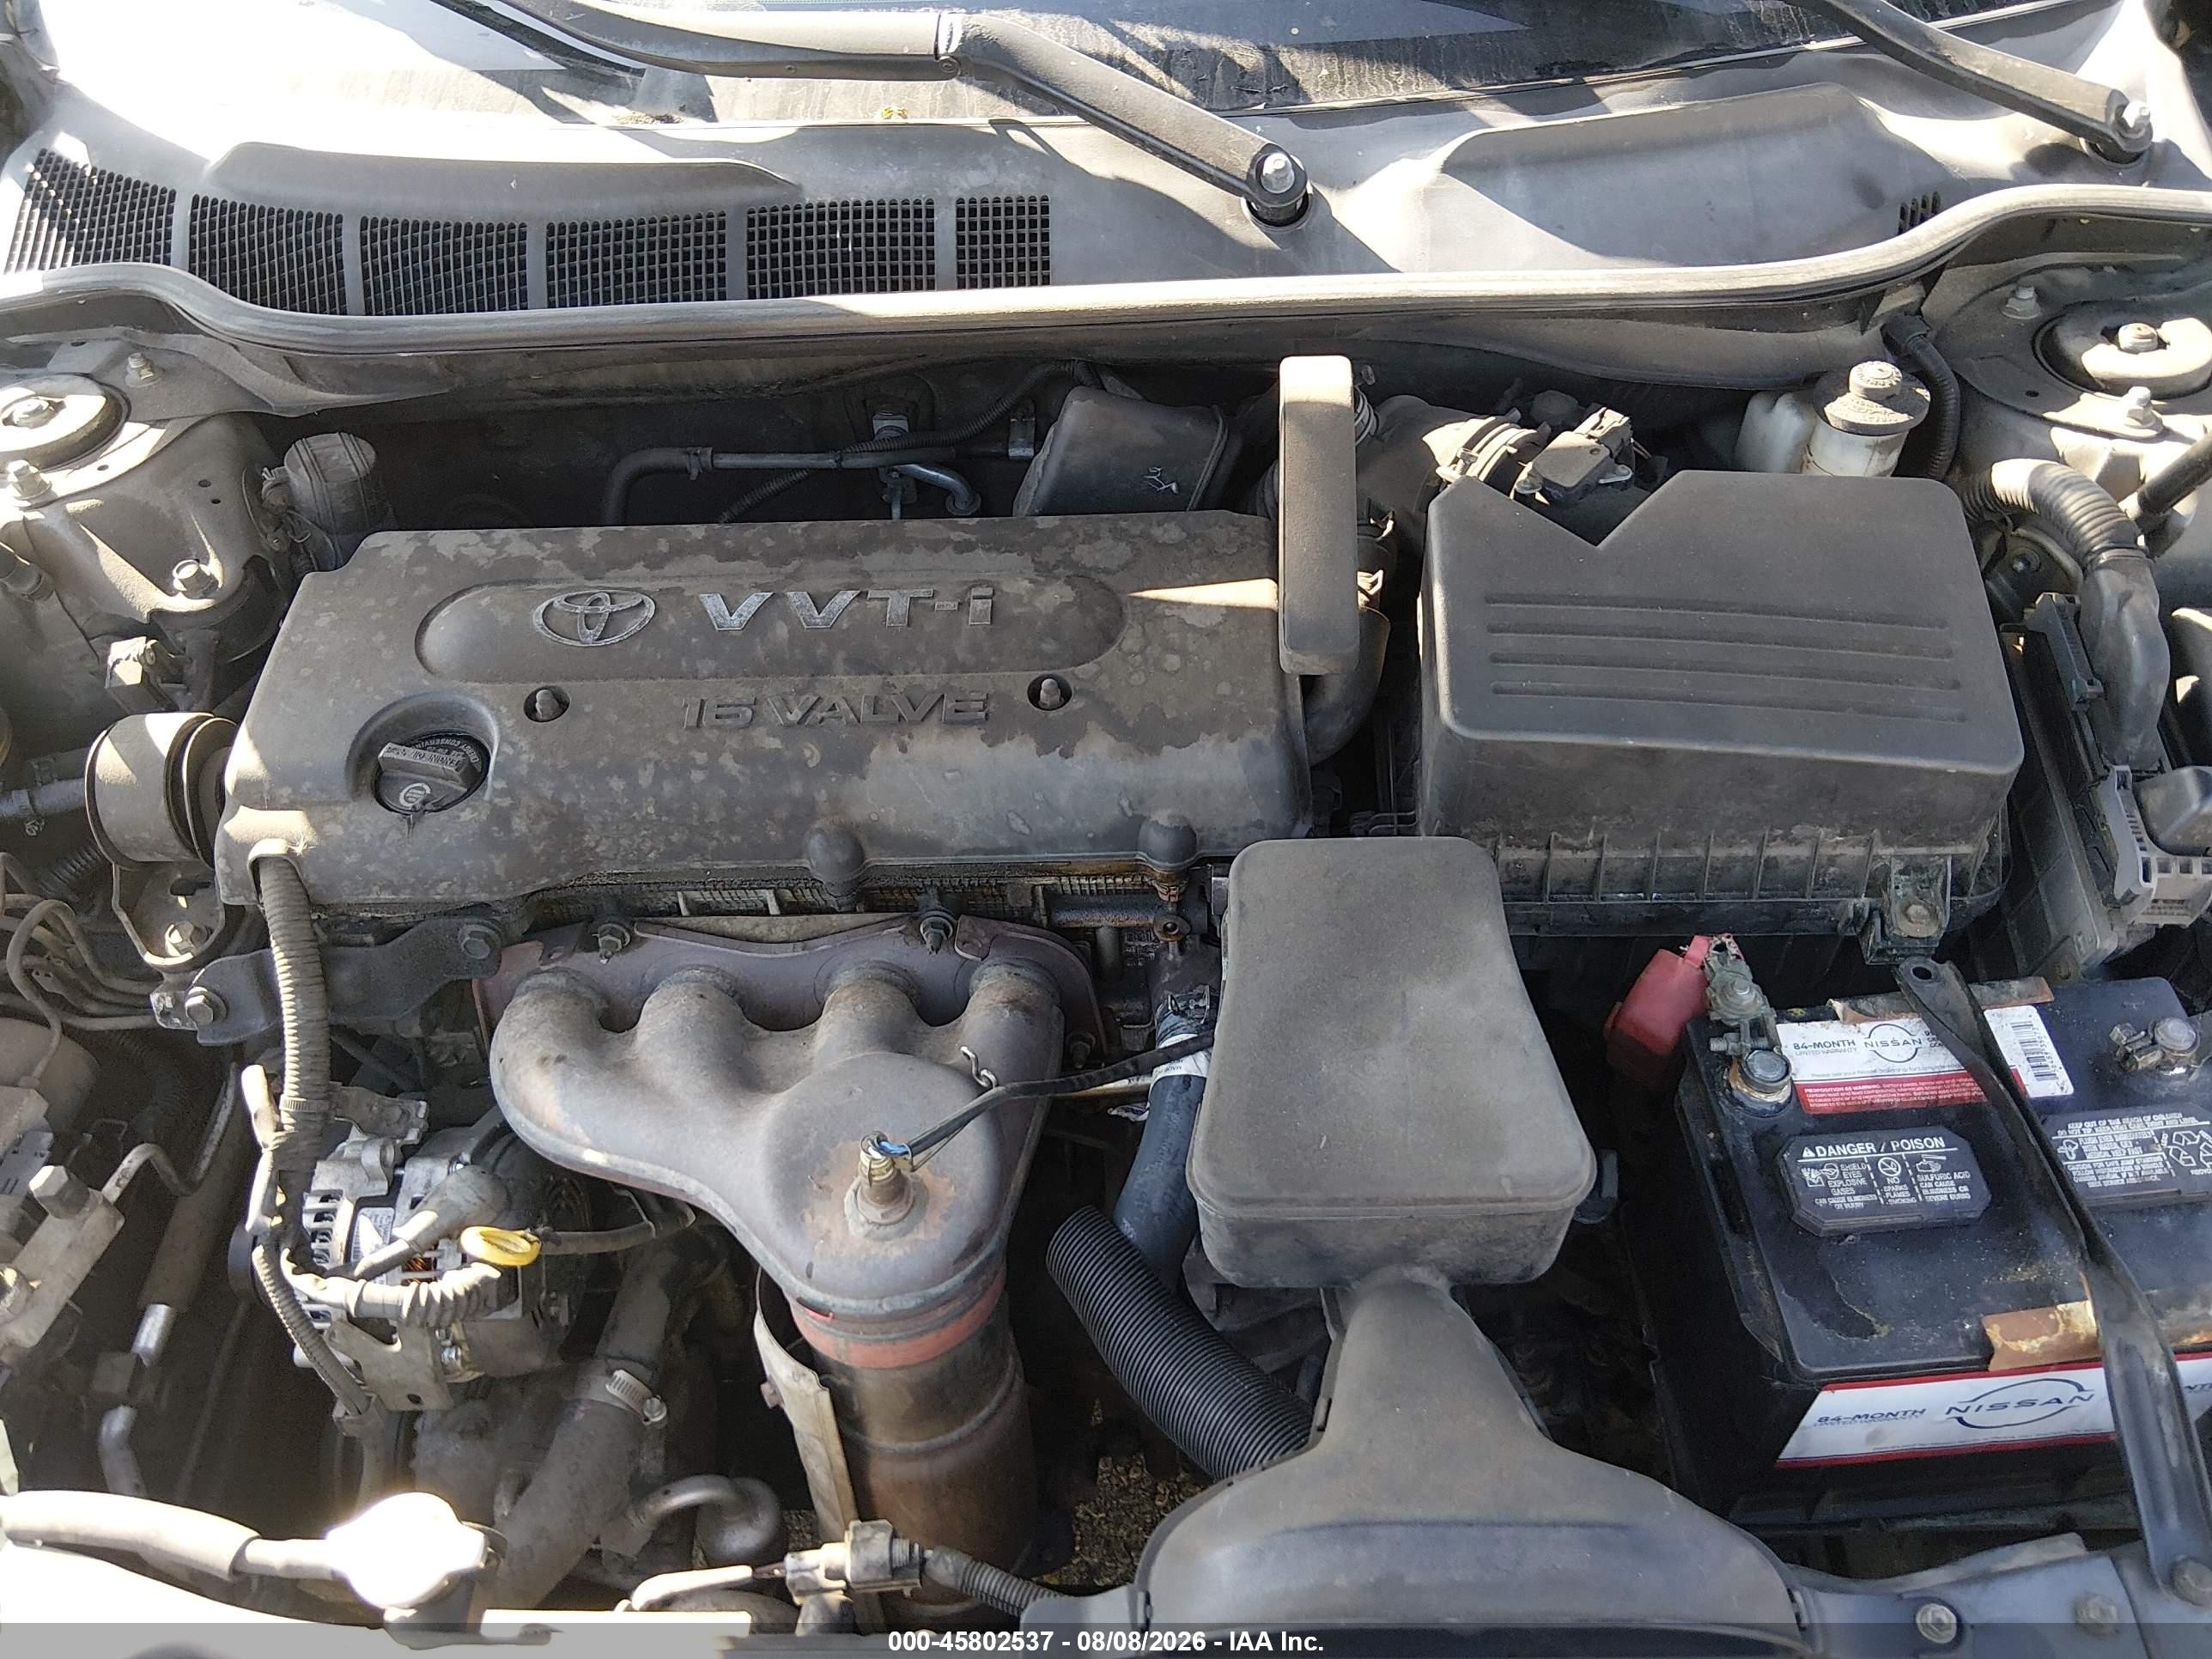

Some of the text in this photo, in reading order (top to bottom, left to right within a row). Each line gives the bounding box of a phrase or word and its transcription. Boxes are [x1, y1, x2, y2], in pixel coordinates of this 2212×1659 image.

[699, 587, 994, 631] VVT-i
[684, 692, 989, 729] 16 VALVE
[1793, 1039, 1856, 1050] 84-MONTH
[1864, 1037, 1923, 1048] NISSAN
[1815, 1142, 1877, 1157] DANGER
[1890, 1137, 1946, 1152] POISON
[1840, 1163, 1867, 1171] SHIELD
[1843, 1170, 1862, 1179] EYES
[1917, 1170, 1971, 1182] SULFURIC ACID
[1827, 1178, 1868, 1188] EXPLOSIVE
[1886, 1176, 1900, 1185] NO
[1946, 1394, 2094, 1415] NISSAN
[1817, 1408, 1926, 1423] 84-MONTH
